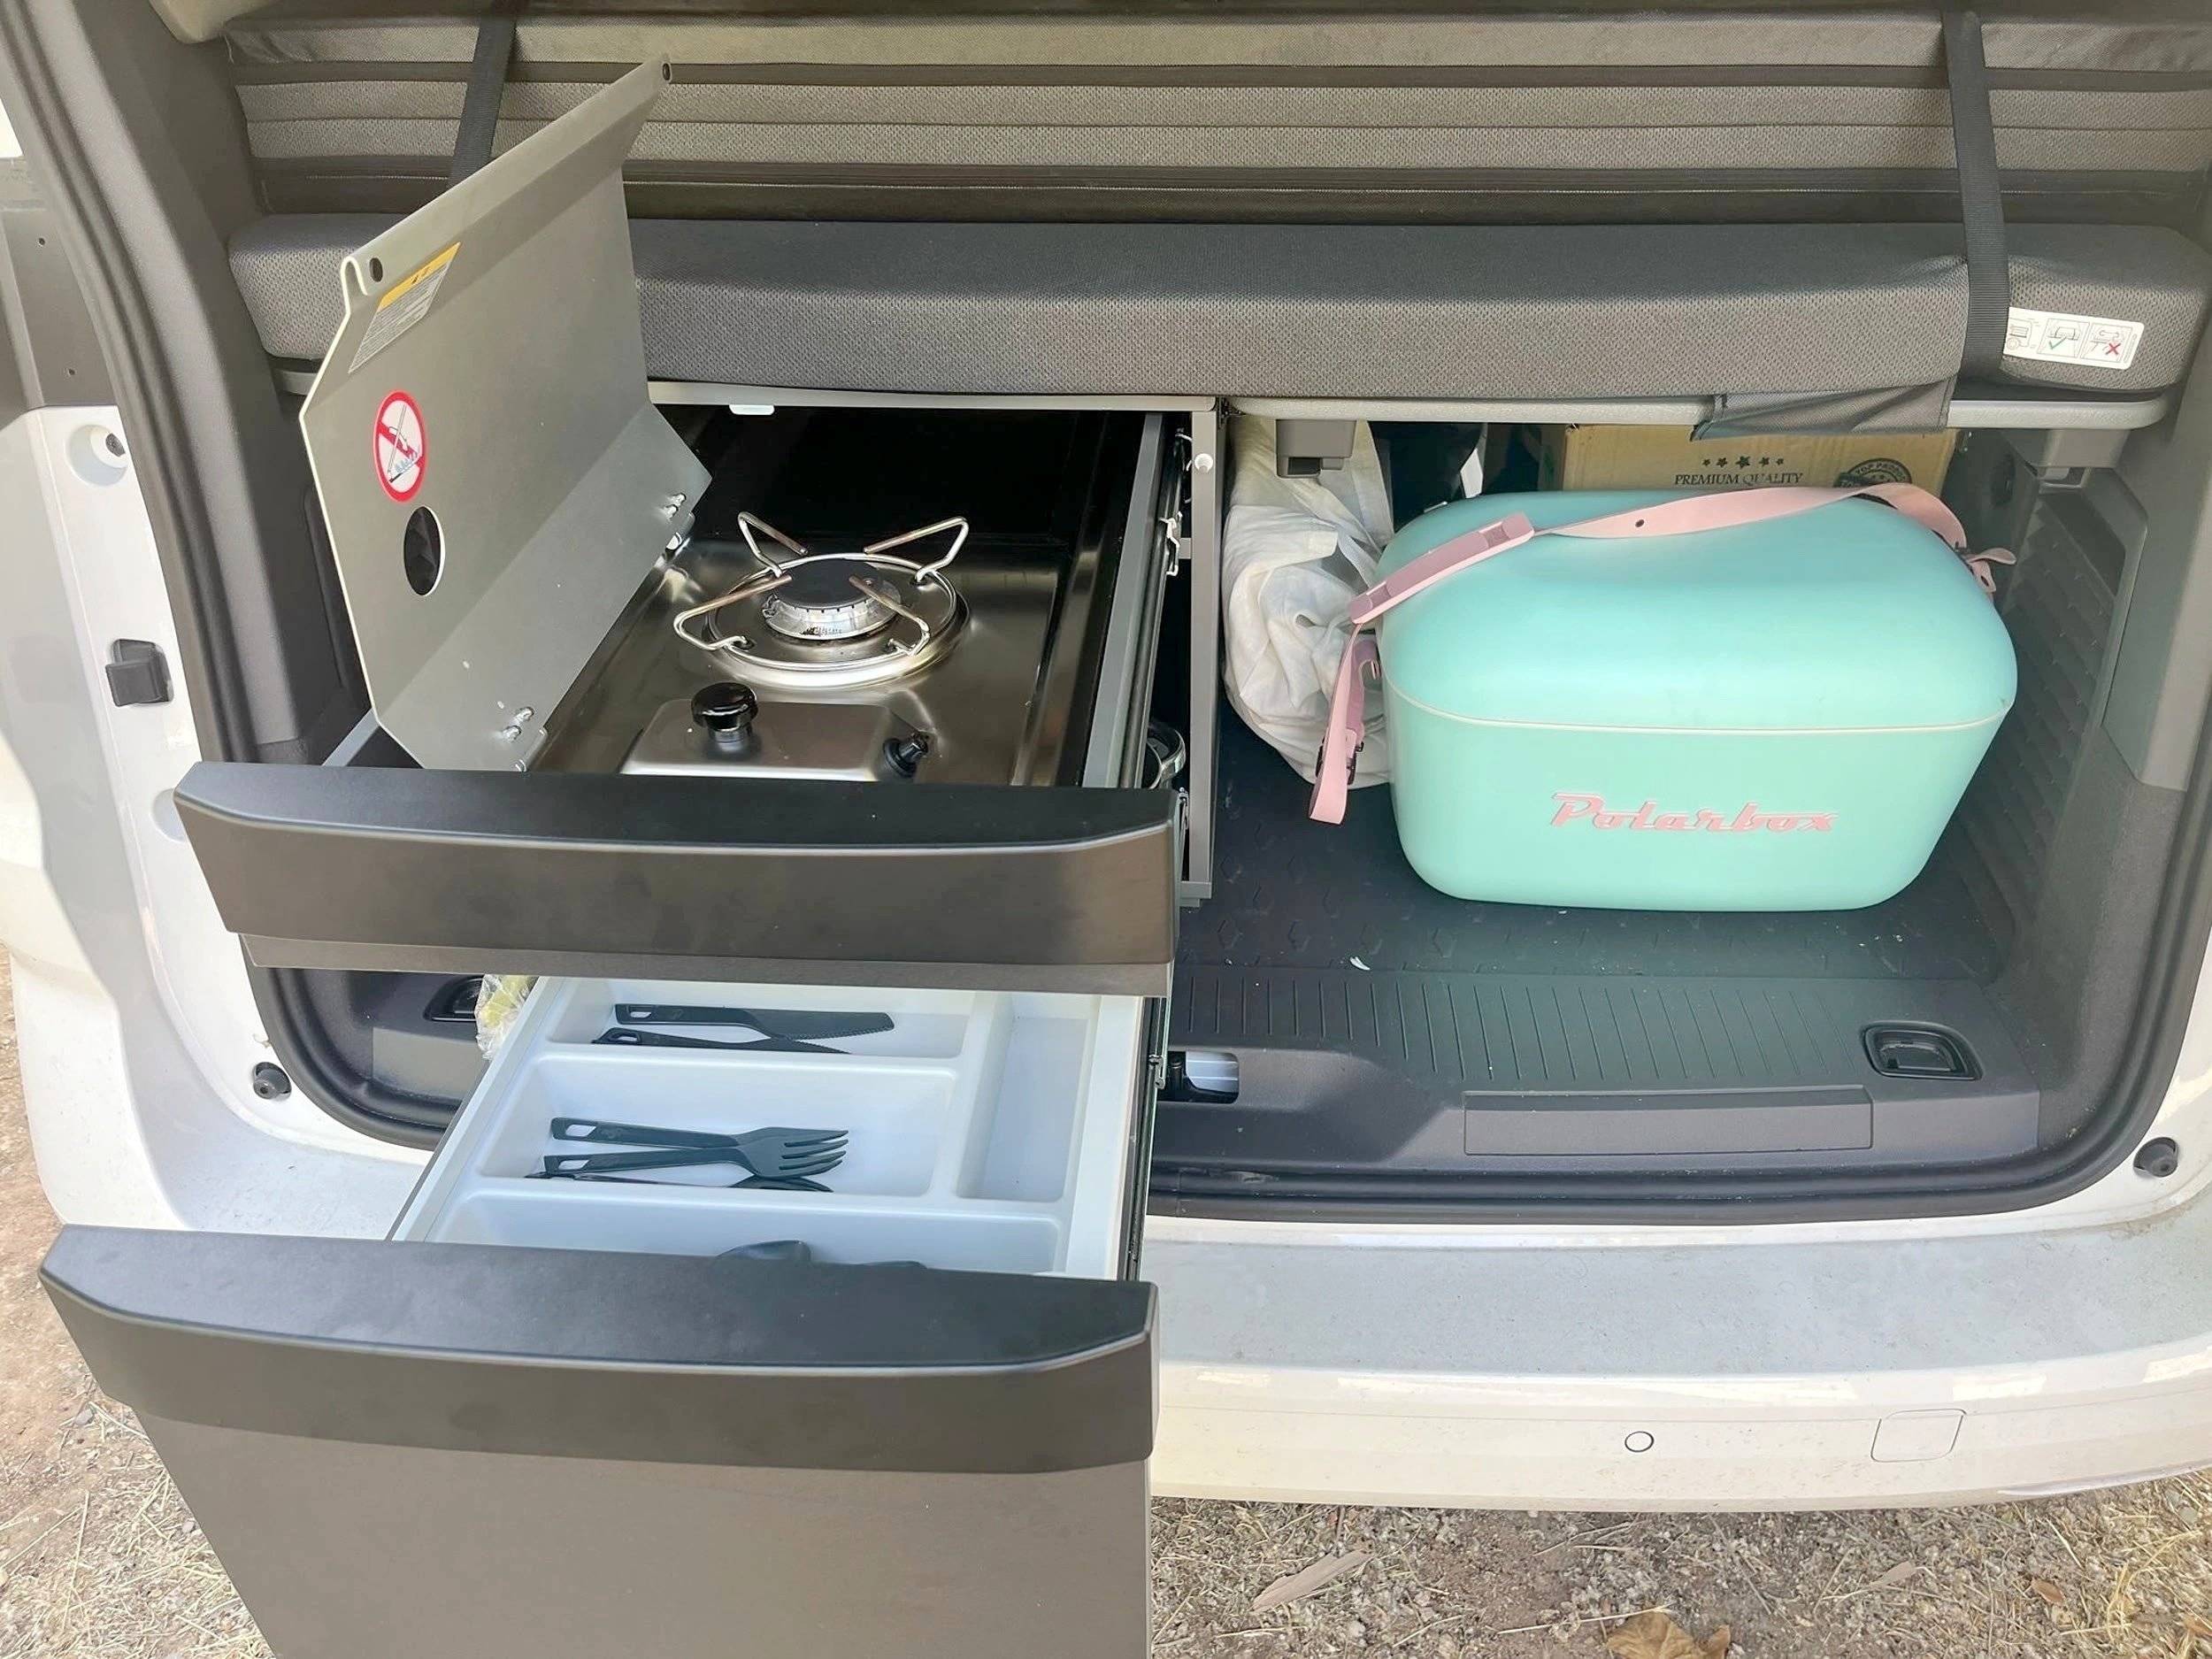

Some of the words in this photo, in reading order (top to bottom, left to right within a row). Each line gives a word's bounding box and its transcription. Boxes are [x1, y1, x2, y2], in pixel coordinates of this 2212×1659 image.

[1674, 474, 1739, 485] PREMIUM
[1742, 472, 1803, 486] QUALITY
[1551, 793, 1838, 832] Polarbox
